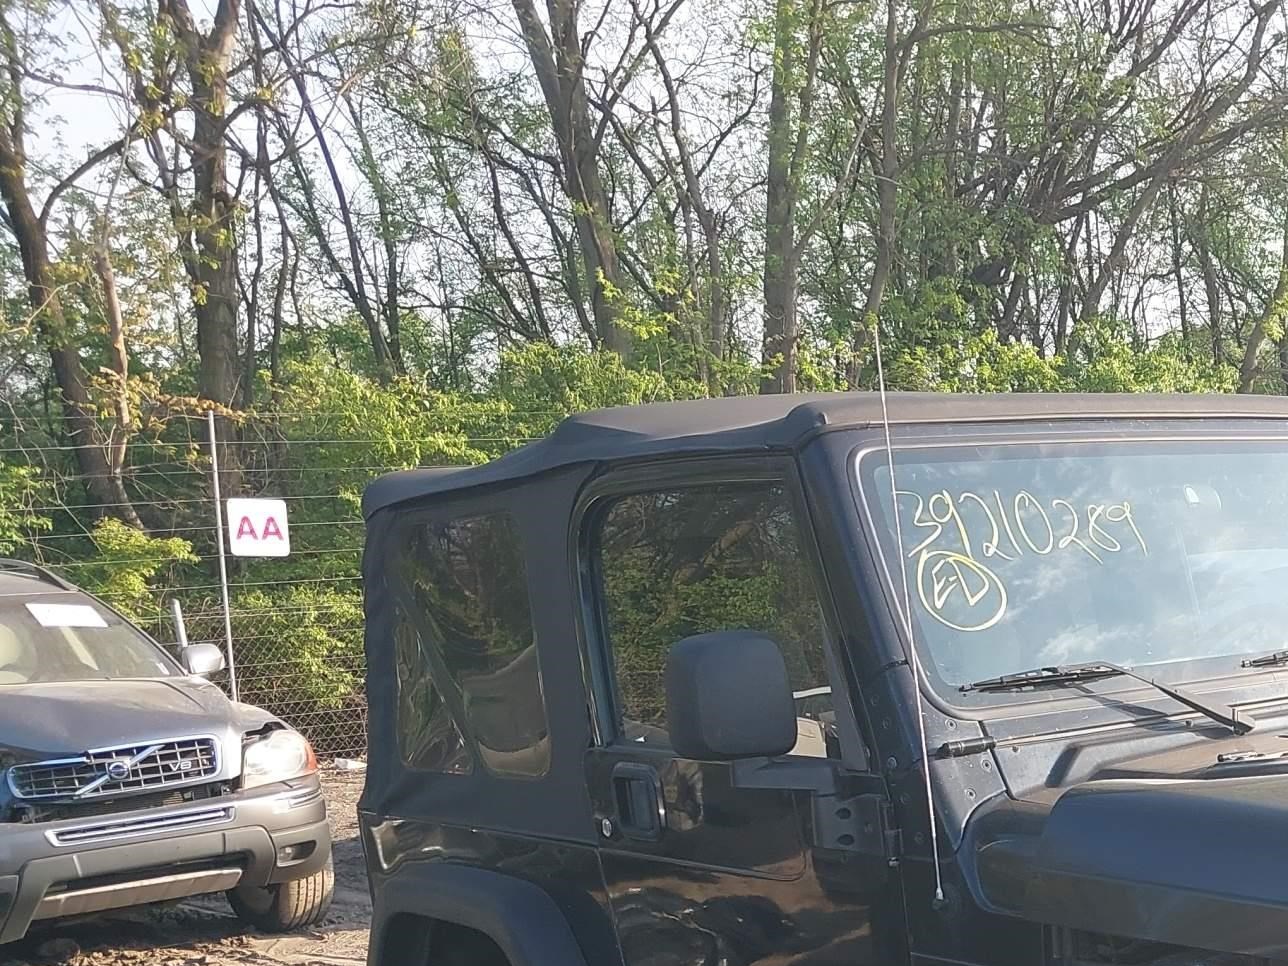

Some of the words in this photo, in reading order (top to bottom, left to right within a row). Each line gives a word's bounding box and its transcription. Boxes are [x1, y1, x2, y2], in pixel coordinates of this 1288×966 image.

[236, 516, 284, 541] AA
[894, 489, 1148, 564] 39210289
[168, 761, 193, 772] V8
